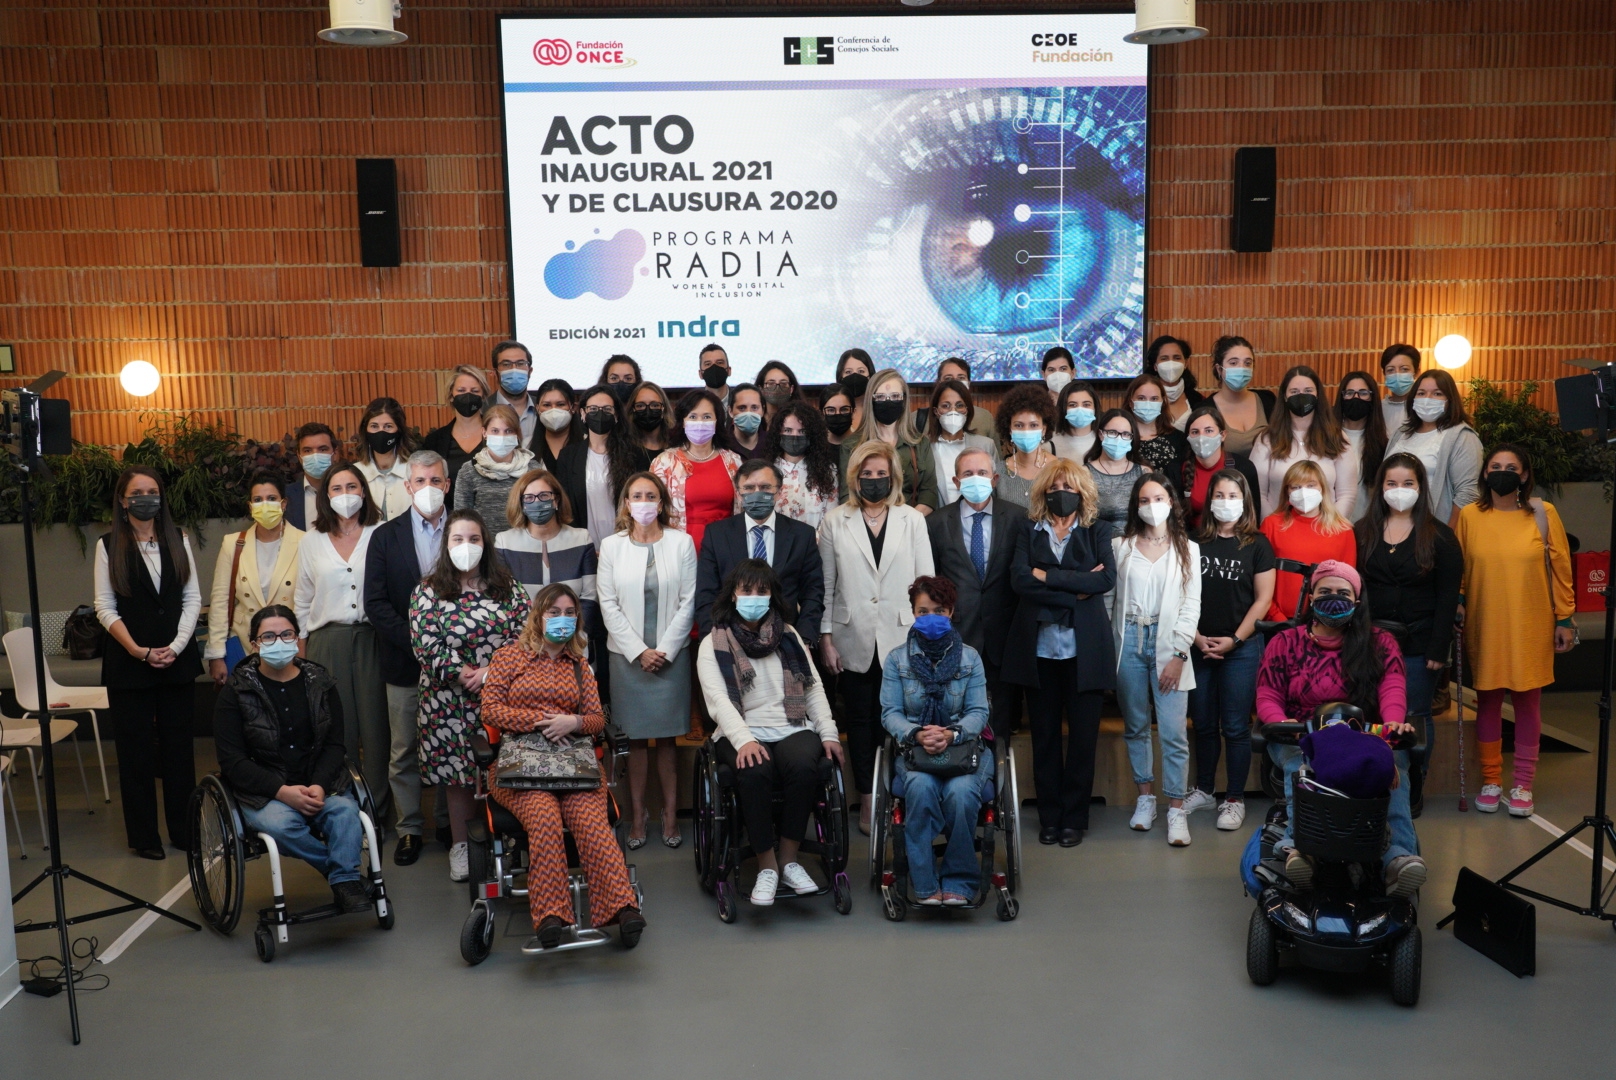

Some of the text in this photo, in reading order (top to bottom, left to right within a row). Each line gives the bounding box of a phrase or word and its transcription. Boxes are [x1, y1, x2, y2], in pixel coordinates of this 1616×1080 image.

[576, 40, 623, 49] Fundación
[837, 36, 880, 44] Conferencia
[1031, 33, 1077, 46] CEOE
[837, 45, 869, 53] Consejos
[1032, 48, 1113, 63] Fundación
[576, 51, 623, 63] ONCE
[540, 114, 694, 156] ACTO
[541, 160, 773, 183] INAUGURAL 2021
[541, 190, 838, 213] Y DE CLAUSURA 2020
[653, 230, 794, 246] PROGRAMA
[656, 250, 799, 279] RADIA
[549, 326, 646, 339] EDICIÓN 2021
[658, 315, 740, 338] indra
